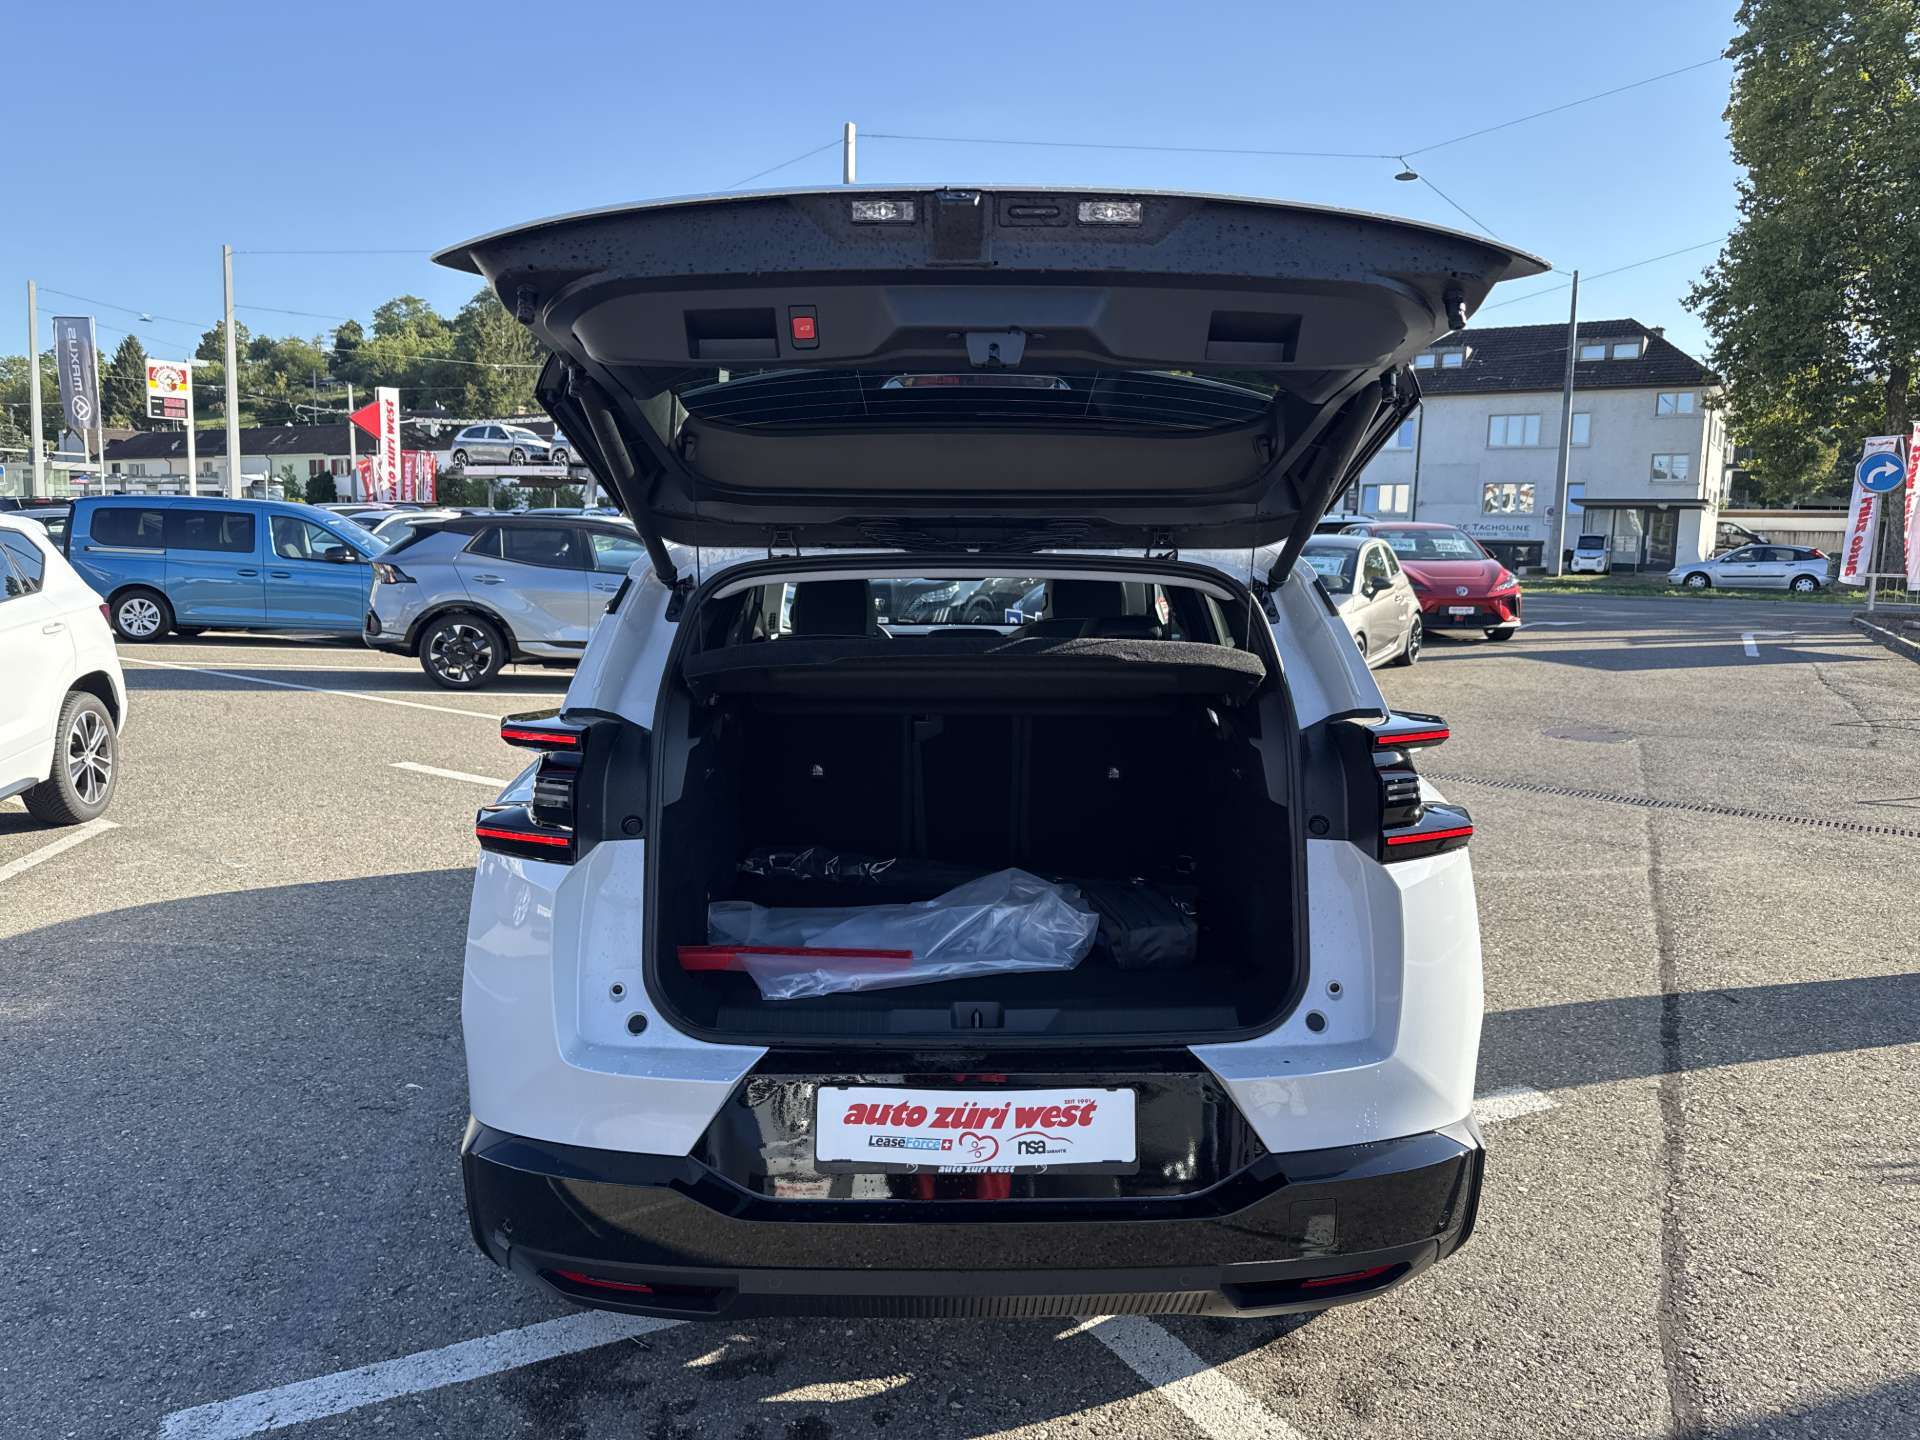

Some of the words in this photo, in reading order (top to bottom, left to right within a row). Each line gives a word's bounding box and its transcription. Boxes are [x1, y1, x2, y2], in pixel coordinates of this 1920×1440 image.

[385, 399, 396, 435] west
[1472, 523, 1530, 532] TACHOLINE
[843, 1100, 928, 1128] auto
[928, 1101, 1012, 1130] züri
[1015, 1099, 1098, 1129] west
[868, 1135, 940, 1151] LeaseForce
[1018, 1140, 1046, 1154] nsa
[938, 1165, 964, 1173] auto
[990, 1166, 1015, 1174] west
